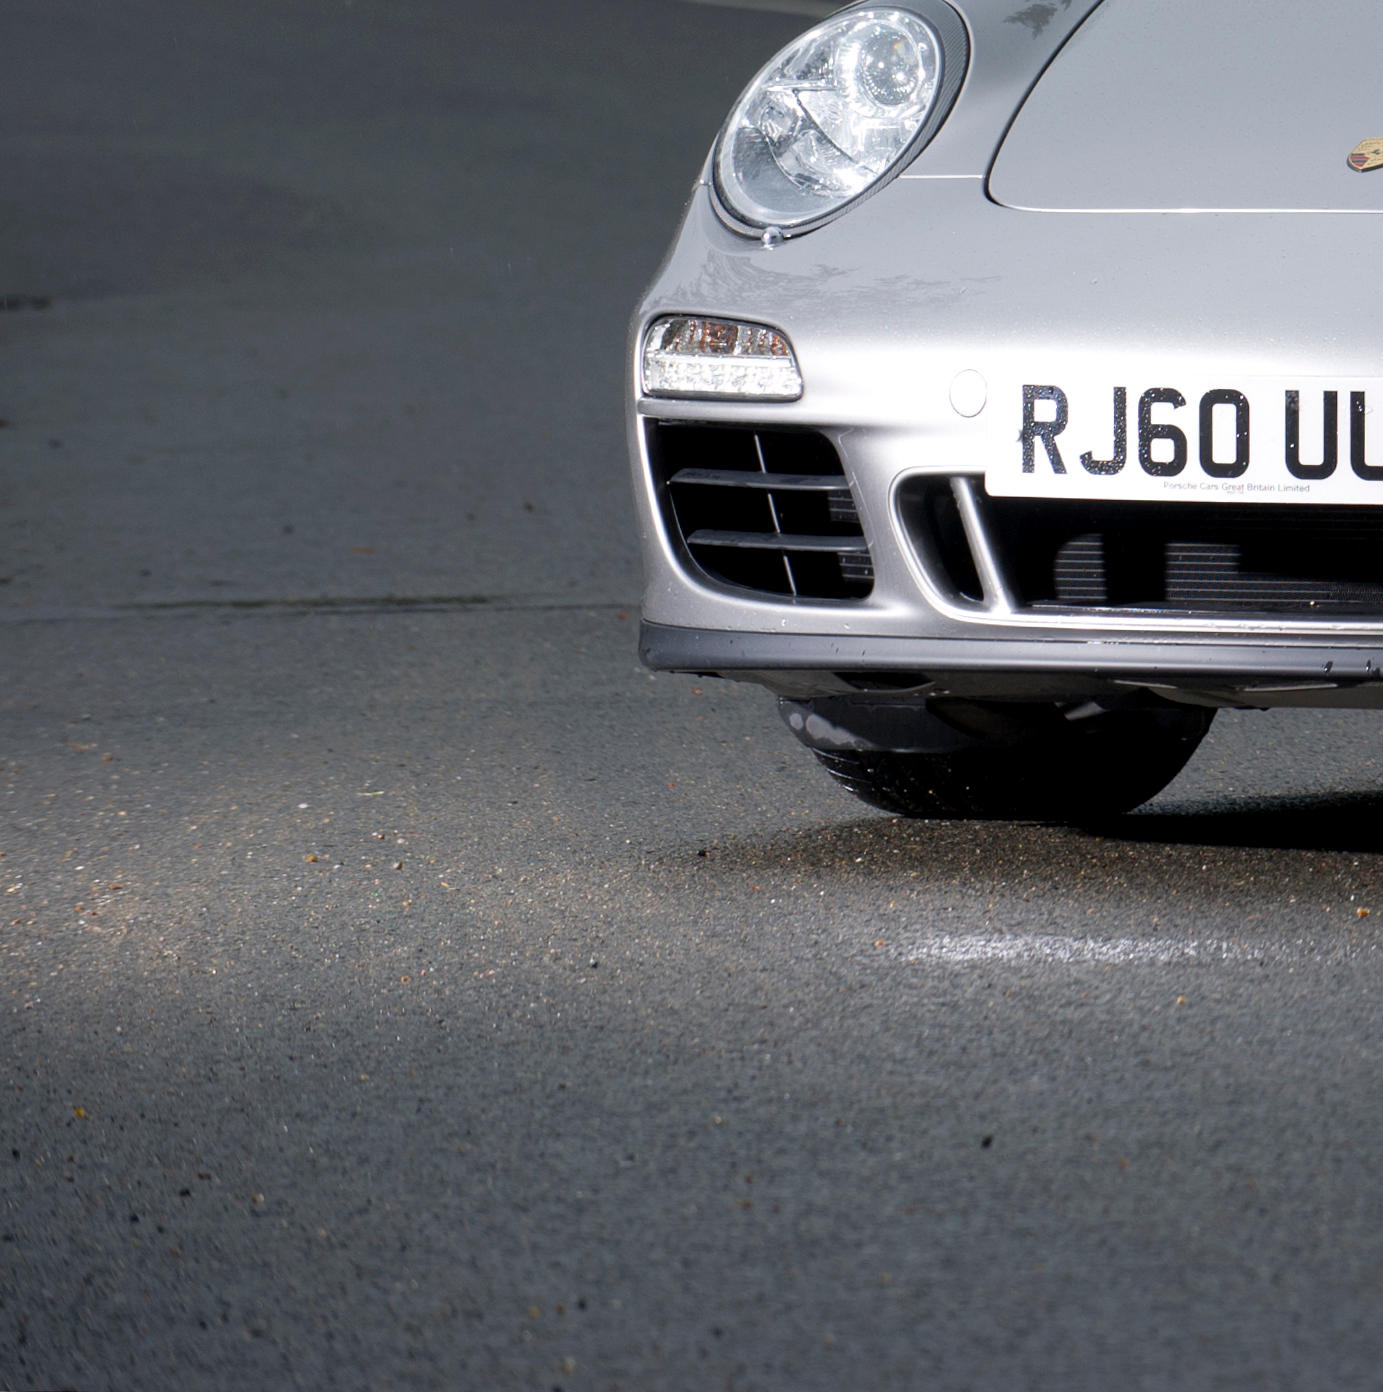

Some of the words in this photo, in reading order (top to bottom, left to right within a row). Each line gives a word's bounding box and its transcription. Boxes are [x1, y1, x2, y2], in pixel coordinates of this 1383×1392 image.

[1021, 384, 1251, 479] RJ60
[1163, 481, 1198, 490] Porsche
[1200, 482, 1219, 491] Cars
[1221, 482, 1245, 492] Great
[1247, 483, 1275, 492] Britain
[1277, 483, 1310, 493] Limited
